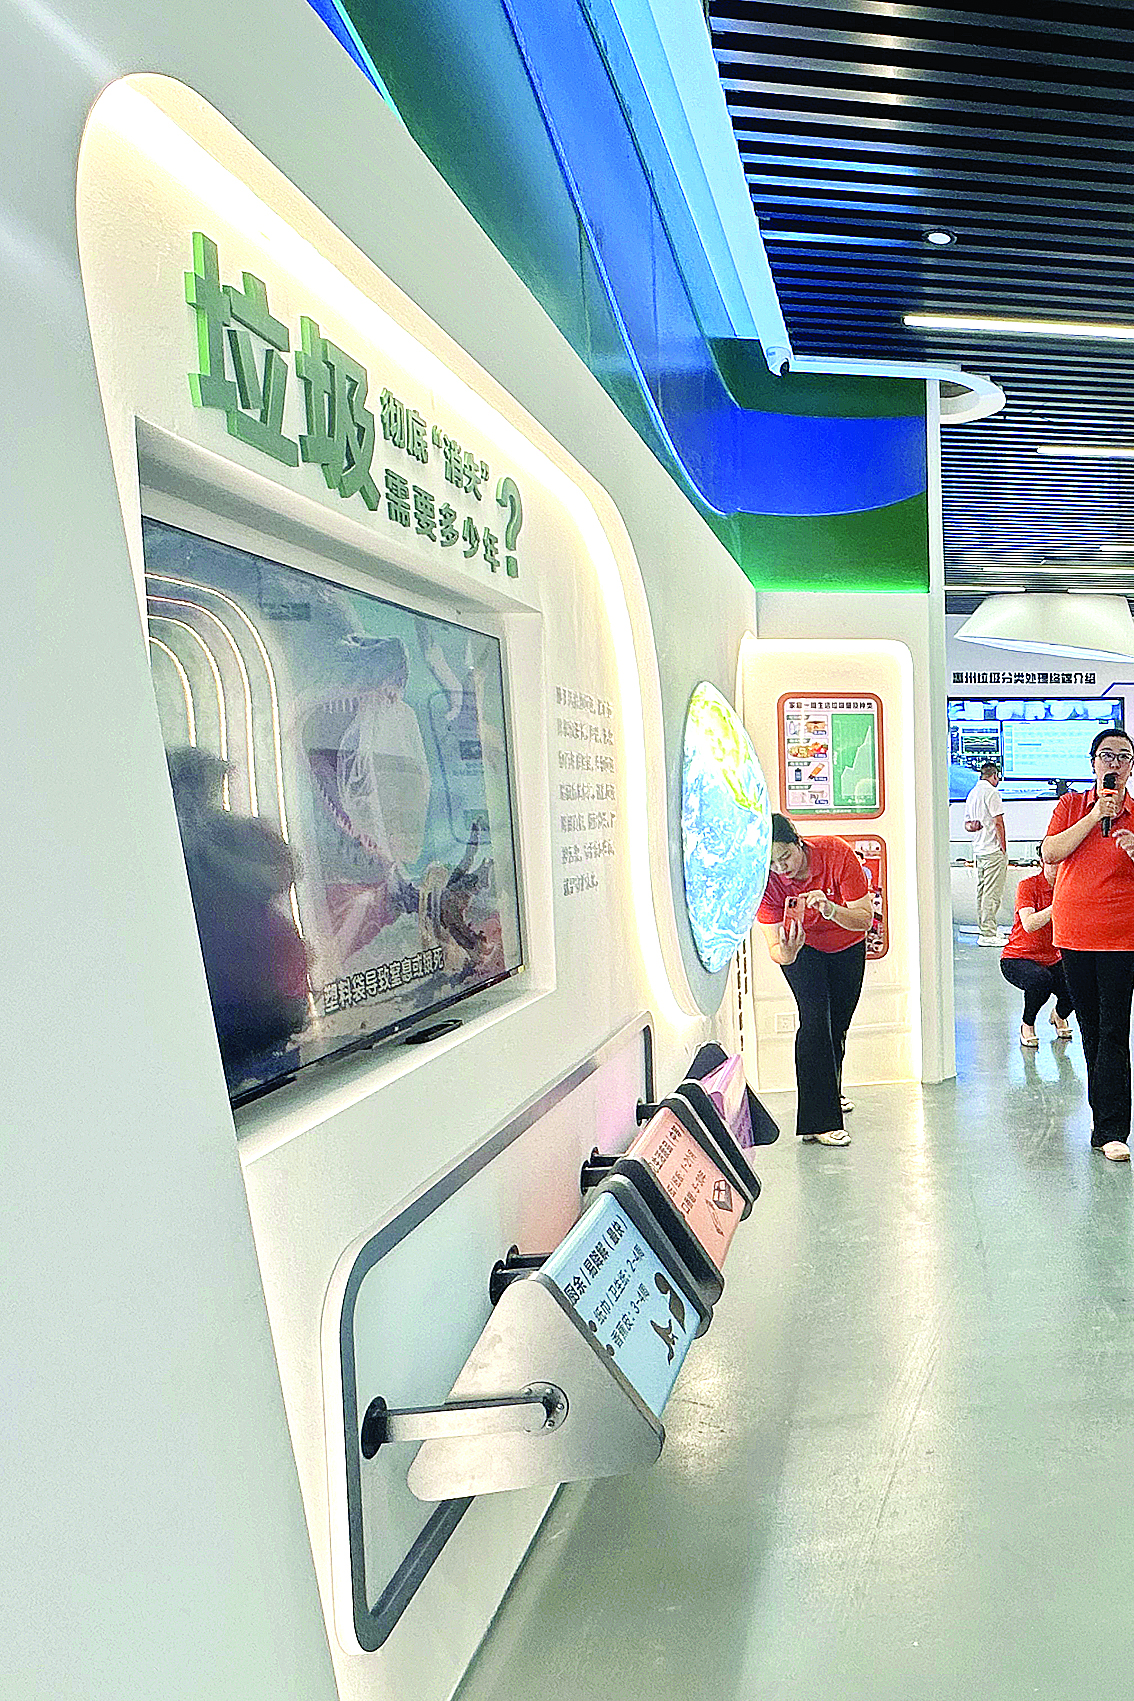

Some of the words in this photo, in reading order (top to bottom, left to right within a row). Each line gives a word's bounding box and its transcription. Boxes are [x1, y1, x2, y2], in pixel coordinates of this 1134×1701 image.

[185, 232, 381, 511] 垃圾
[385, 469, 500, 573] 需要多少年
